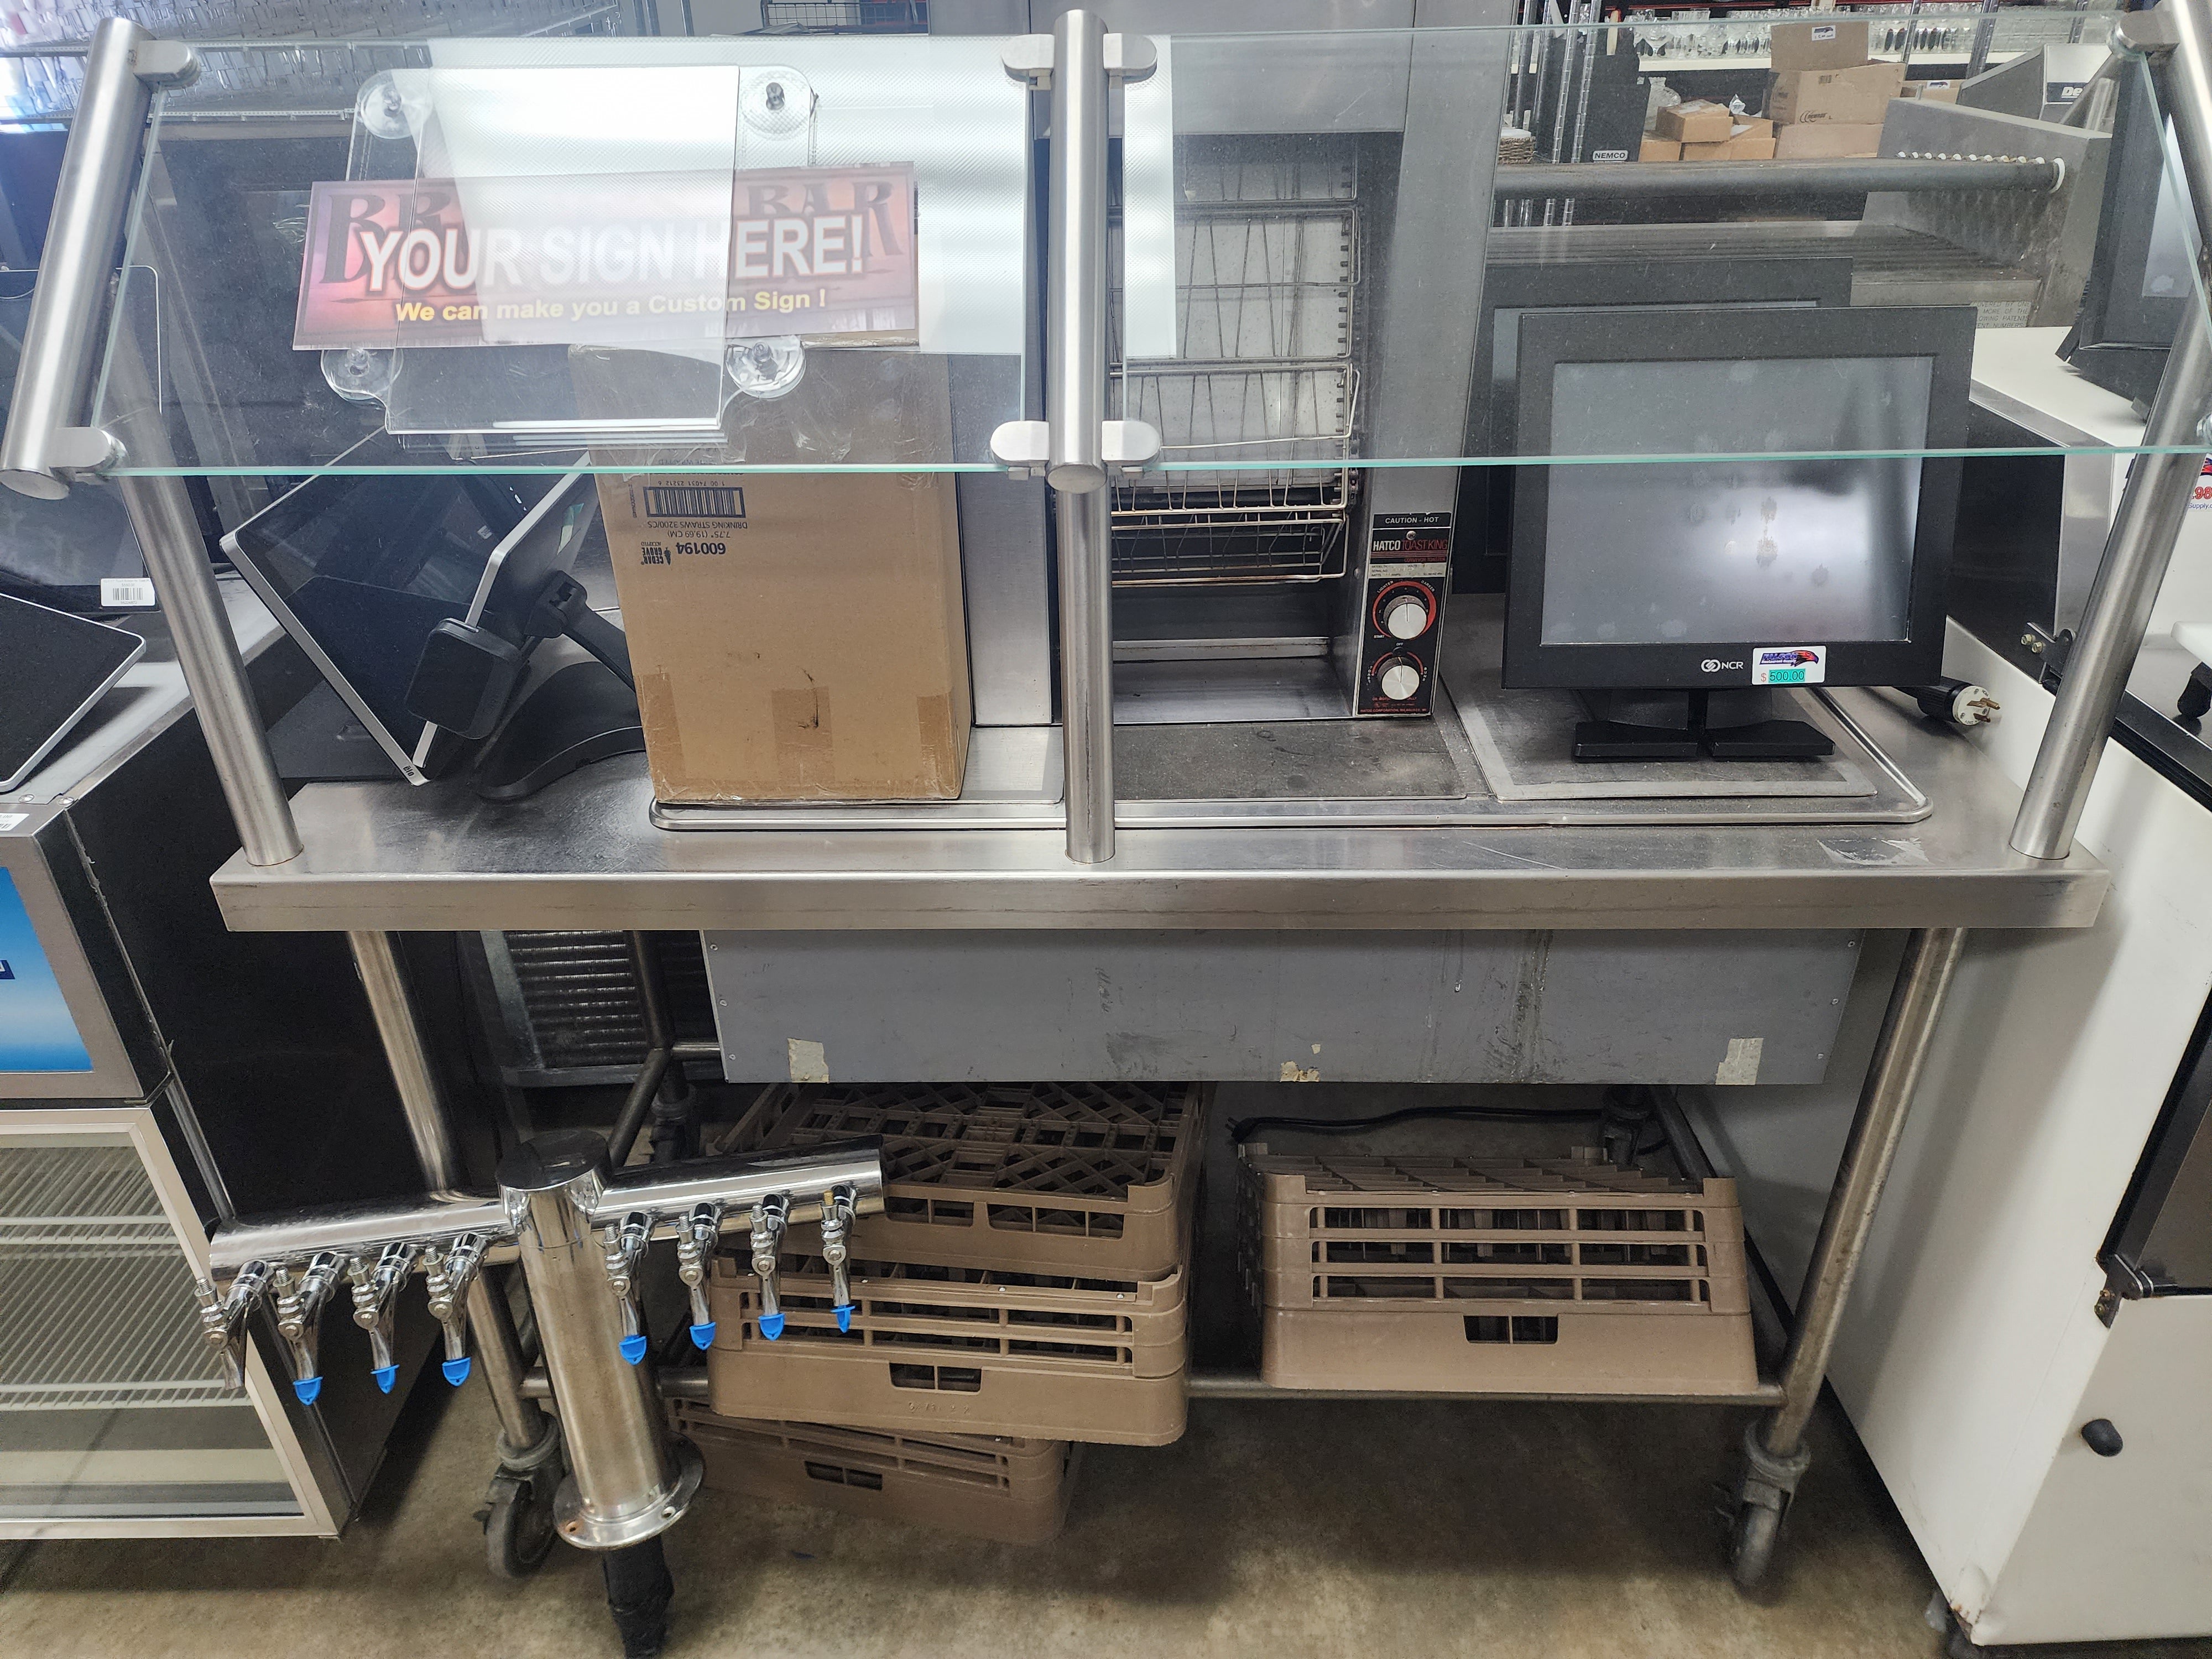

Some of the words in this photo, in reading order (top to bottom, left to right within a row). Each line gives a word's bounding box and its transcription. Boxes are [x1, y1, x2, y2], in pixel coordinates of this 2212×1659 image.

[358, 226, 522, 291] YOUR
[538, 223, 674, 286] SIGN
[694, 214, 864, 280] HERE!
[396, 302, 435, 321] We
[442, 305, 488, 321] can
[496, 300, 564, 319] make
[571, 302, 617, 322] you
[626, 301, 640, 315] a
[648, 294, 746, 314] Custom
[754, 290, 810, 314] Sign
[642, 547, 662, 555] GROVE
[676, 542, 726, 555] 600194
[1373, 540, 1401, 551] HATCO
[1377, 580, 1394, 593] LIGHTER
[1421, 580, 1435, 592] DARKER
[1721, 661, 1744, 670] NCR
[1760, 672, 1767, 682] $
[1769, 670, 1805, 681] 500.00
